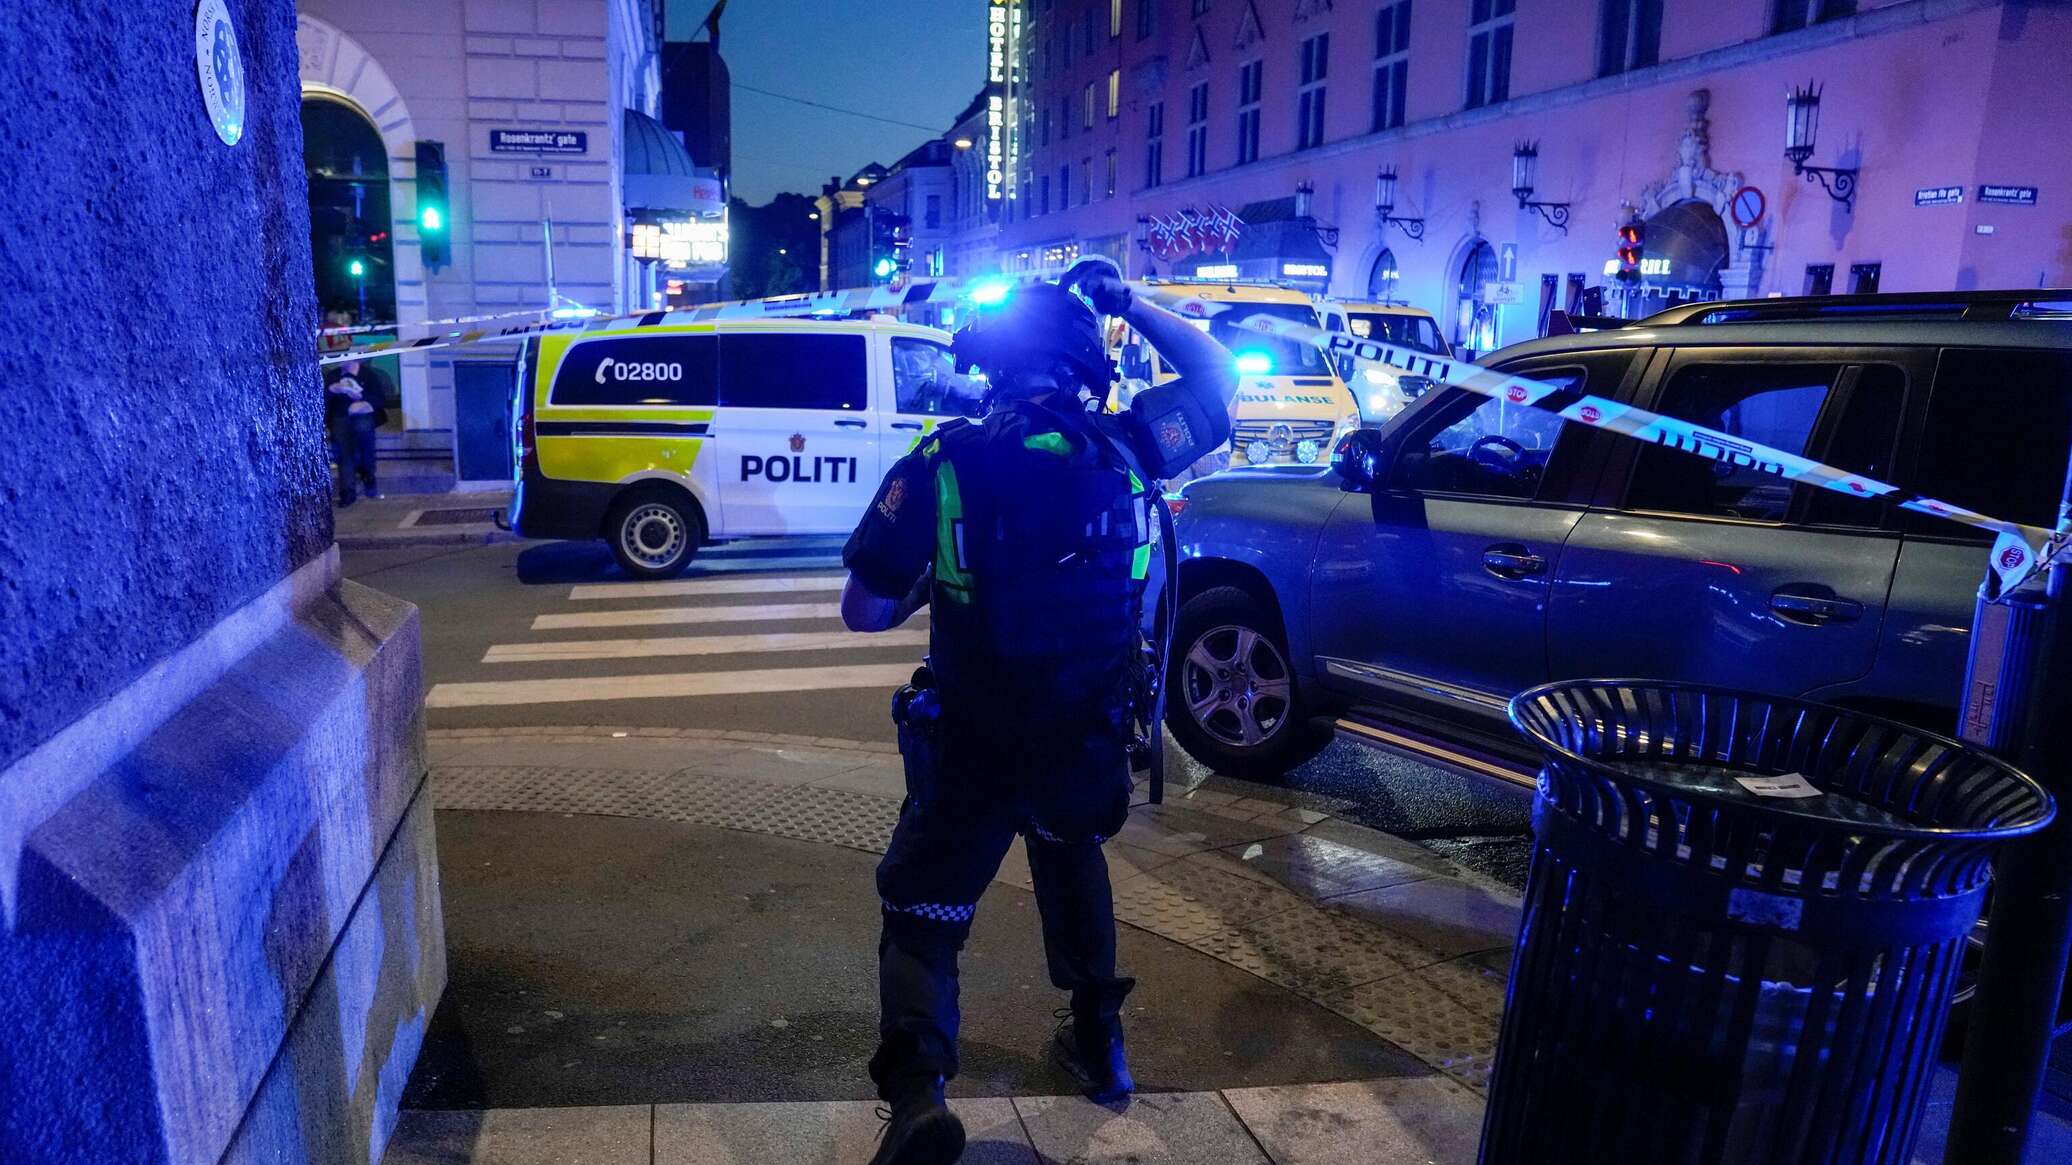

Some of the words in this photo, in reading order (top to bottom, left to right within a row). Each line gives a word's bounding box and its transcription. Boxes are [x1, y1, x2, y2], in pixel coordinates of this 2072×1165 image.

[989, 7, 1006, 83] HOTEL
[557, 134, 577, 147] gate
[986, 96, 1003, 199] BRISTOL
[1328, 336, 1450, 380] POLITI
[614, 363, 682, 381] 02800
[1508, 387, 1528, 398] STOP
[740, 455, 857, 483] POLITI
[877, 501, 897, 523] POLITI
[2004, 547, 2023, 568] STOP
